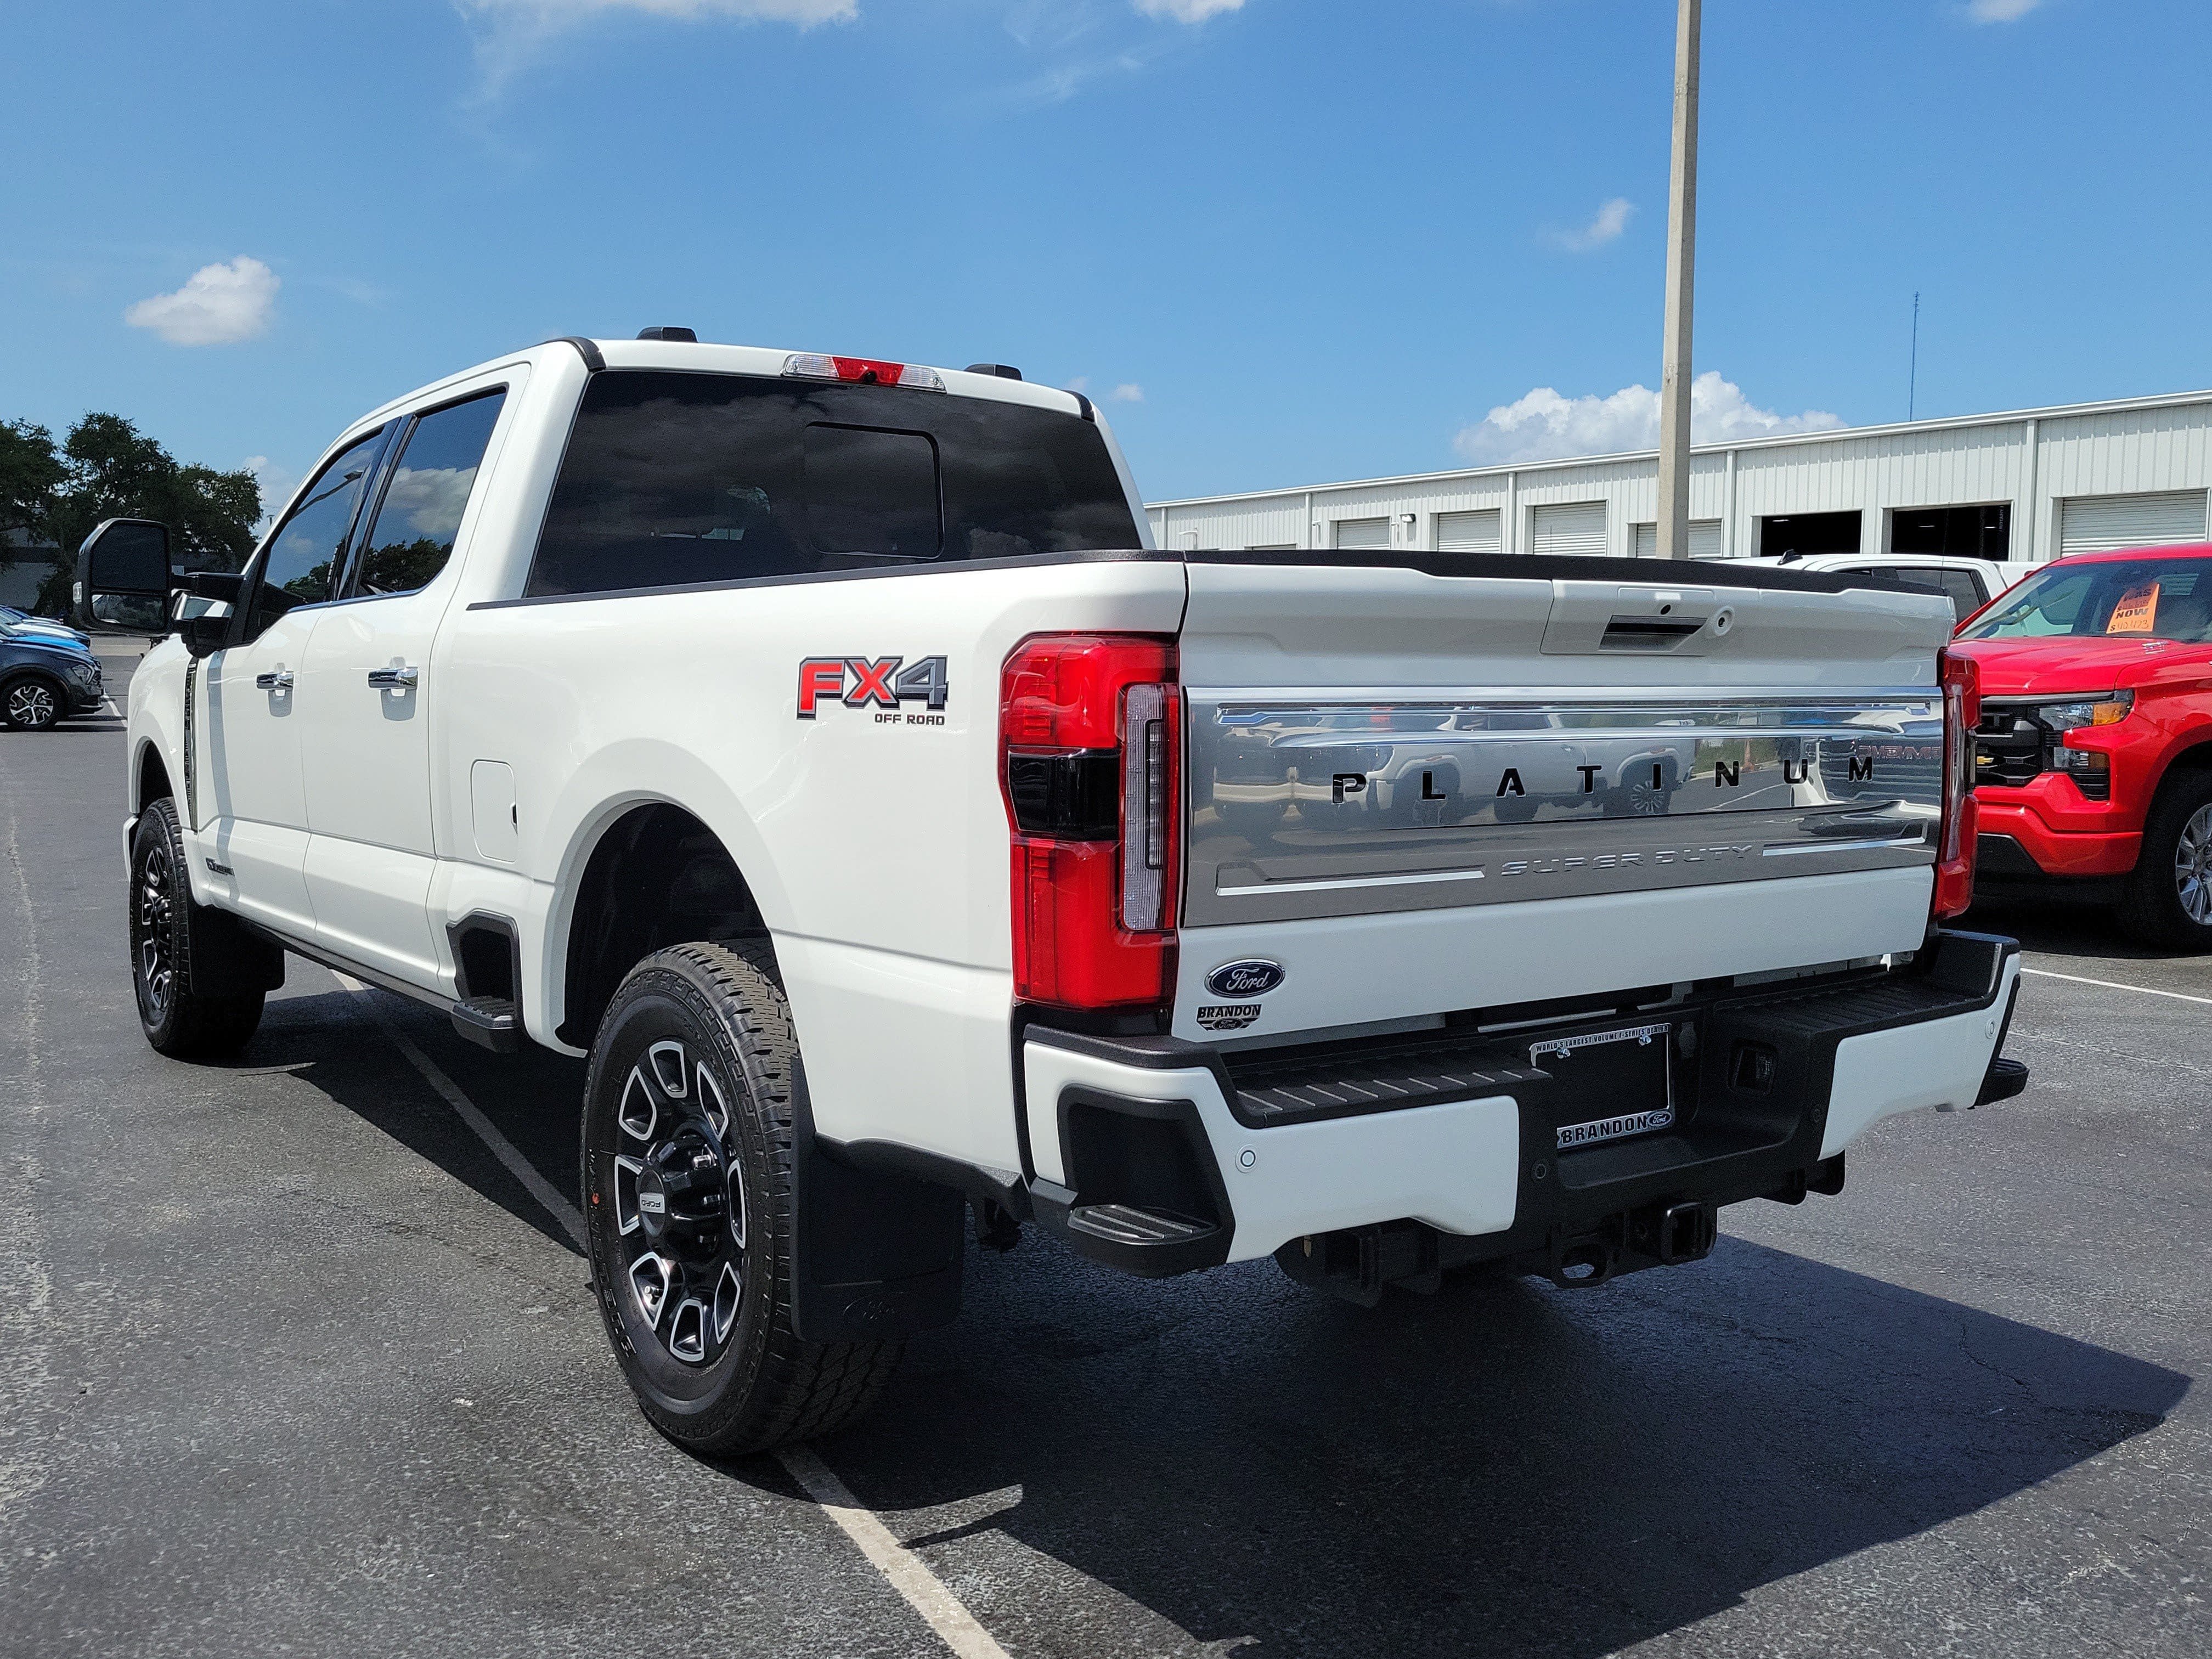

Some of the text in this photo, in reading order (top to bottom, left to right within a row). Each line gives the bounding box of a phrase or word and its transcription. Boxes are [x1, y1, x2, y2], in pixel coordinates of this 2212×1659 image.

[2116, 607, 2149, 619] NOW
[797, 655, 949, 720] FX4
[874, 713, 945, 725] OFF ROAD
[1332, 755, 1873, 804] PLATINUM
[1501, 845, 1753, 876] SUPER DUTY
[1226, 968, 1270, 991] Ford
[1197, 1005, 1261, 1018] BRANDON
[1566, 1037, 1592, 1047] LARGEST
[1594, 1032, 1617, 1042] VOLUME
[1561, 1115, 1646, 1144] BRANDON
